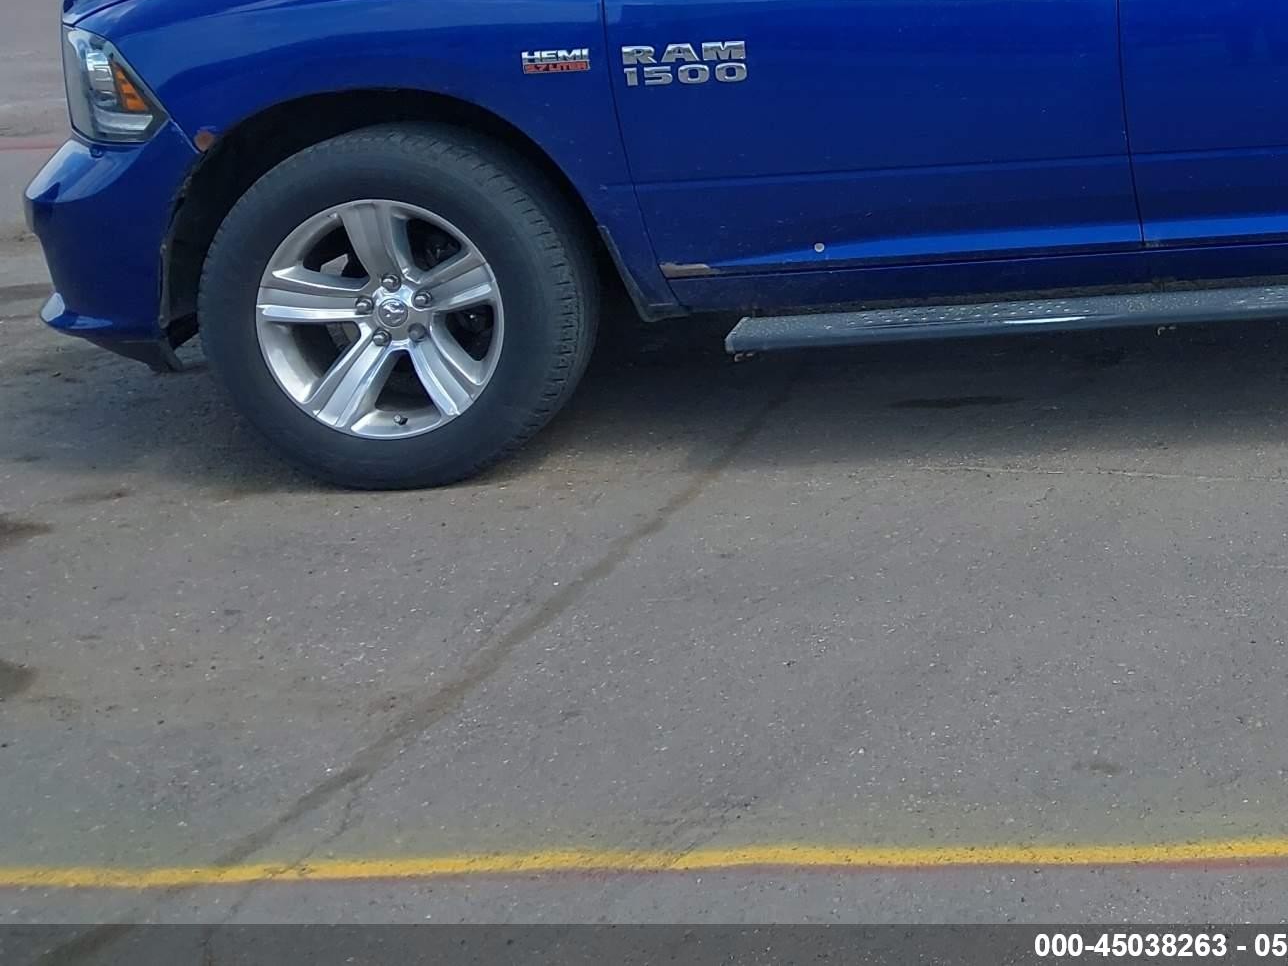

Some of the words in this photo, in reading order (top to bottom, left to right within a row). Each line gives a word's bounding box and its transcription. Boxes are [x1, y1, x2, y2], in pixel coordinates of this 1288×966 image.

[521, 48, 589, 64] HEMI
[621, 40, 746, 65] RAM
[623, 62, 747, 86] 1500
